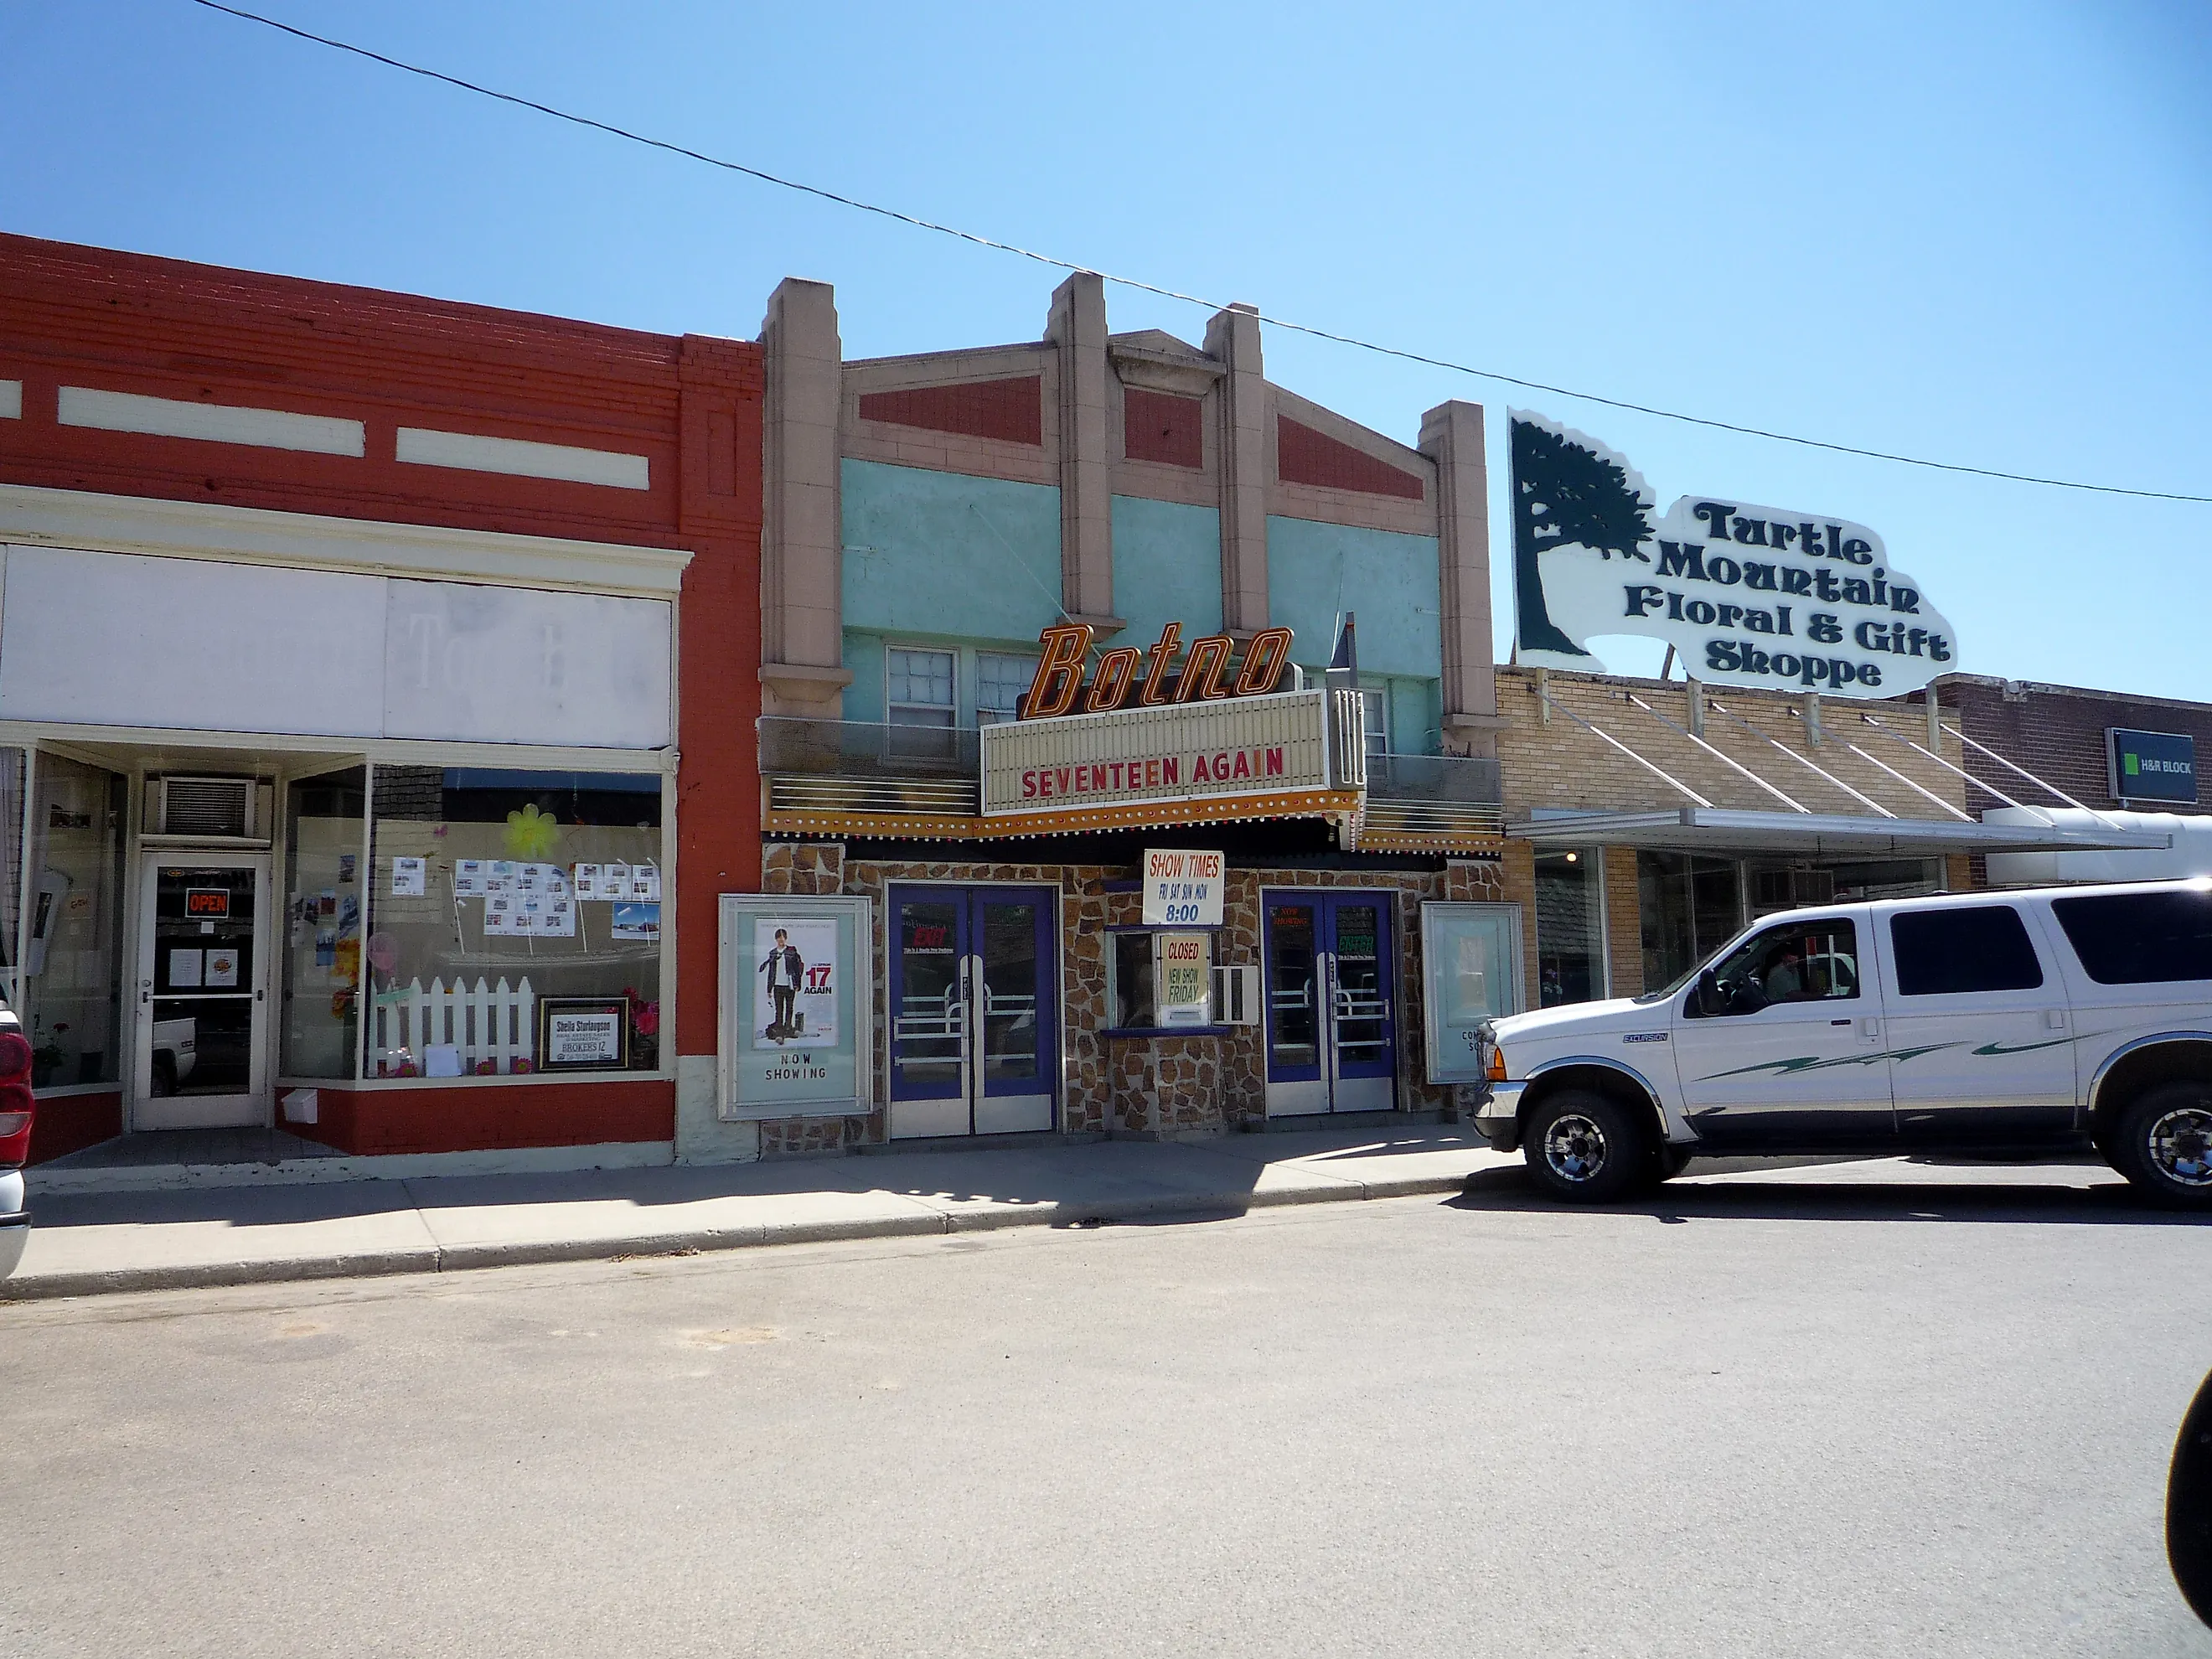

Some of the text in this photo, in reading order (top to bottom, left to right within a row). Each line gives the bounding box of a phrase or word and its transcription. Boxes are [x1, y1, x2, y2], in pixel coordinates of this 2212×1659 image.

[1693, 502, 1873, 566] Turtle
[1656, 539, 1920, 615] Mountain
[1624, 585, 1951, 662] Floral & Gift
[1019, 622, 1295, 721] Botno
[1706, 640, 1883, 690] Shoppe
[1022, 747, 1284, 797] SEVENTEEN AGAIN
[2141, 759, 2192, 773] H&R BLOCK
[1150, 854, 1219, 878] SHOW TIMES
[1159, 882, 1207, 900] FRI SAT SUN MON
[189, 895, 226, 912] OPEN
[1166, 904, 1198, 922] 8:00
[1168, 943, 1199, 959] CLOSED
[806, 967, 831, 986] 17
[1169, 967, 1199, 984] NEW SHOW
[804, 986, 832, 995] AGAIN
[1168, 985, 1199, 1003] FRIDAY
[1623, 1032, 1668, 1043] EXCURSION
[781, 1054, 811, 1065] NOW
[766, 1067, 825, 1080] SHOWING
